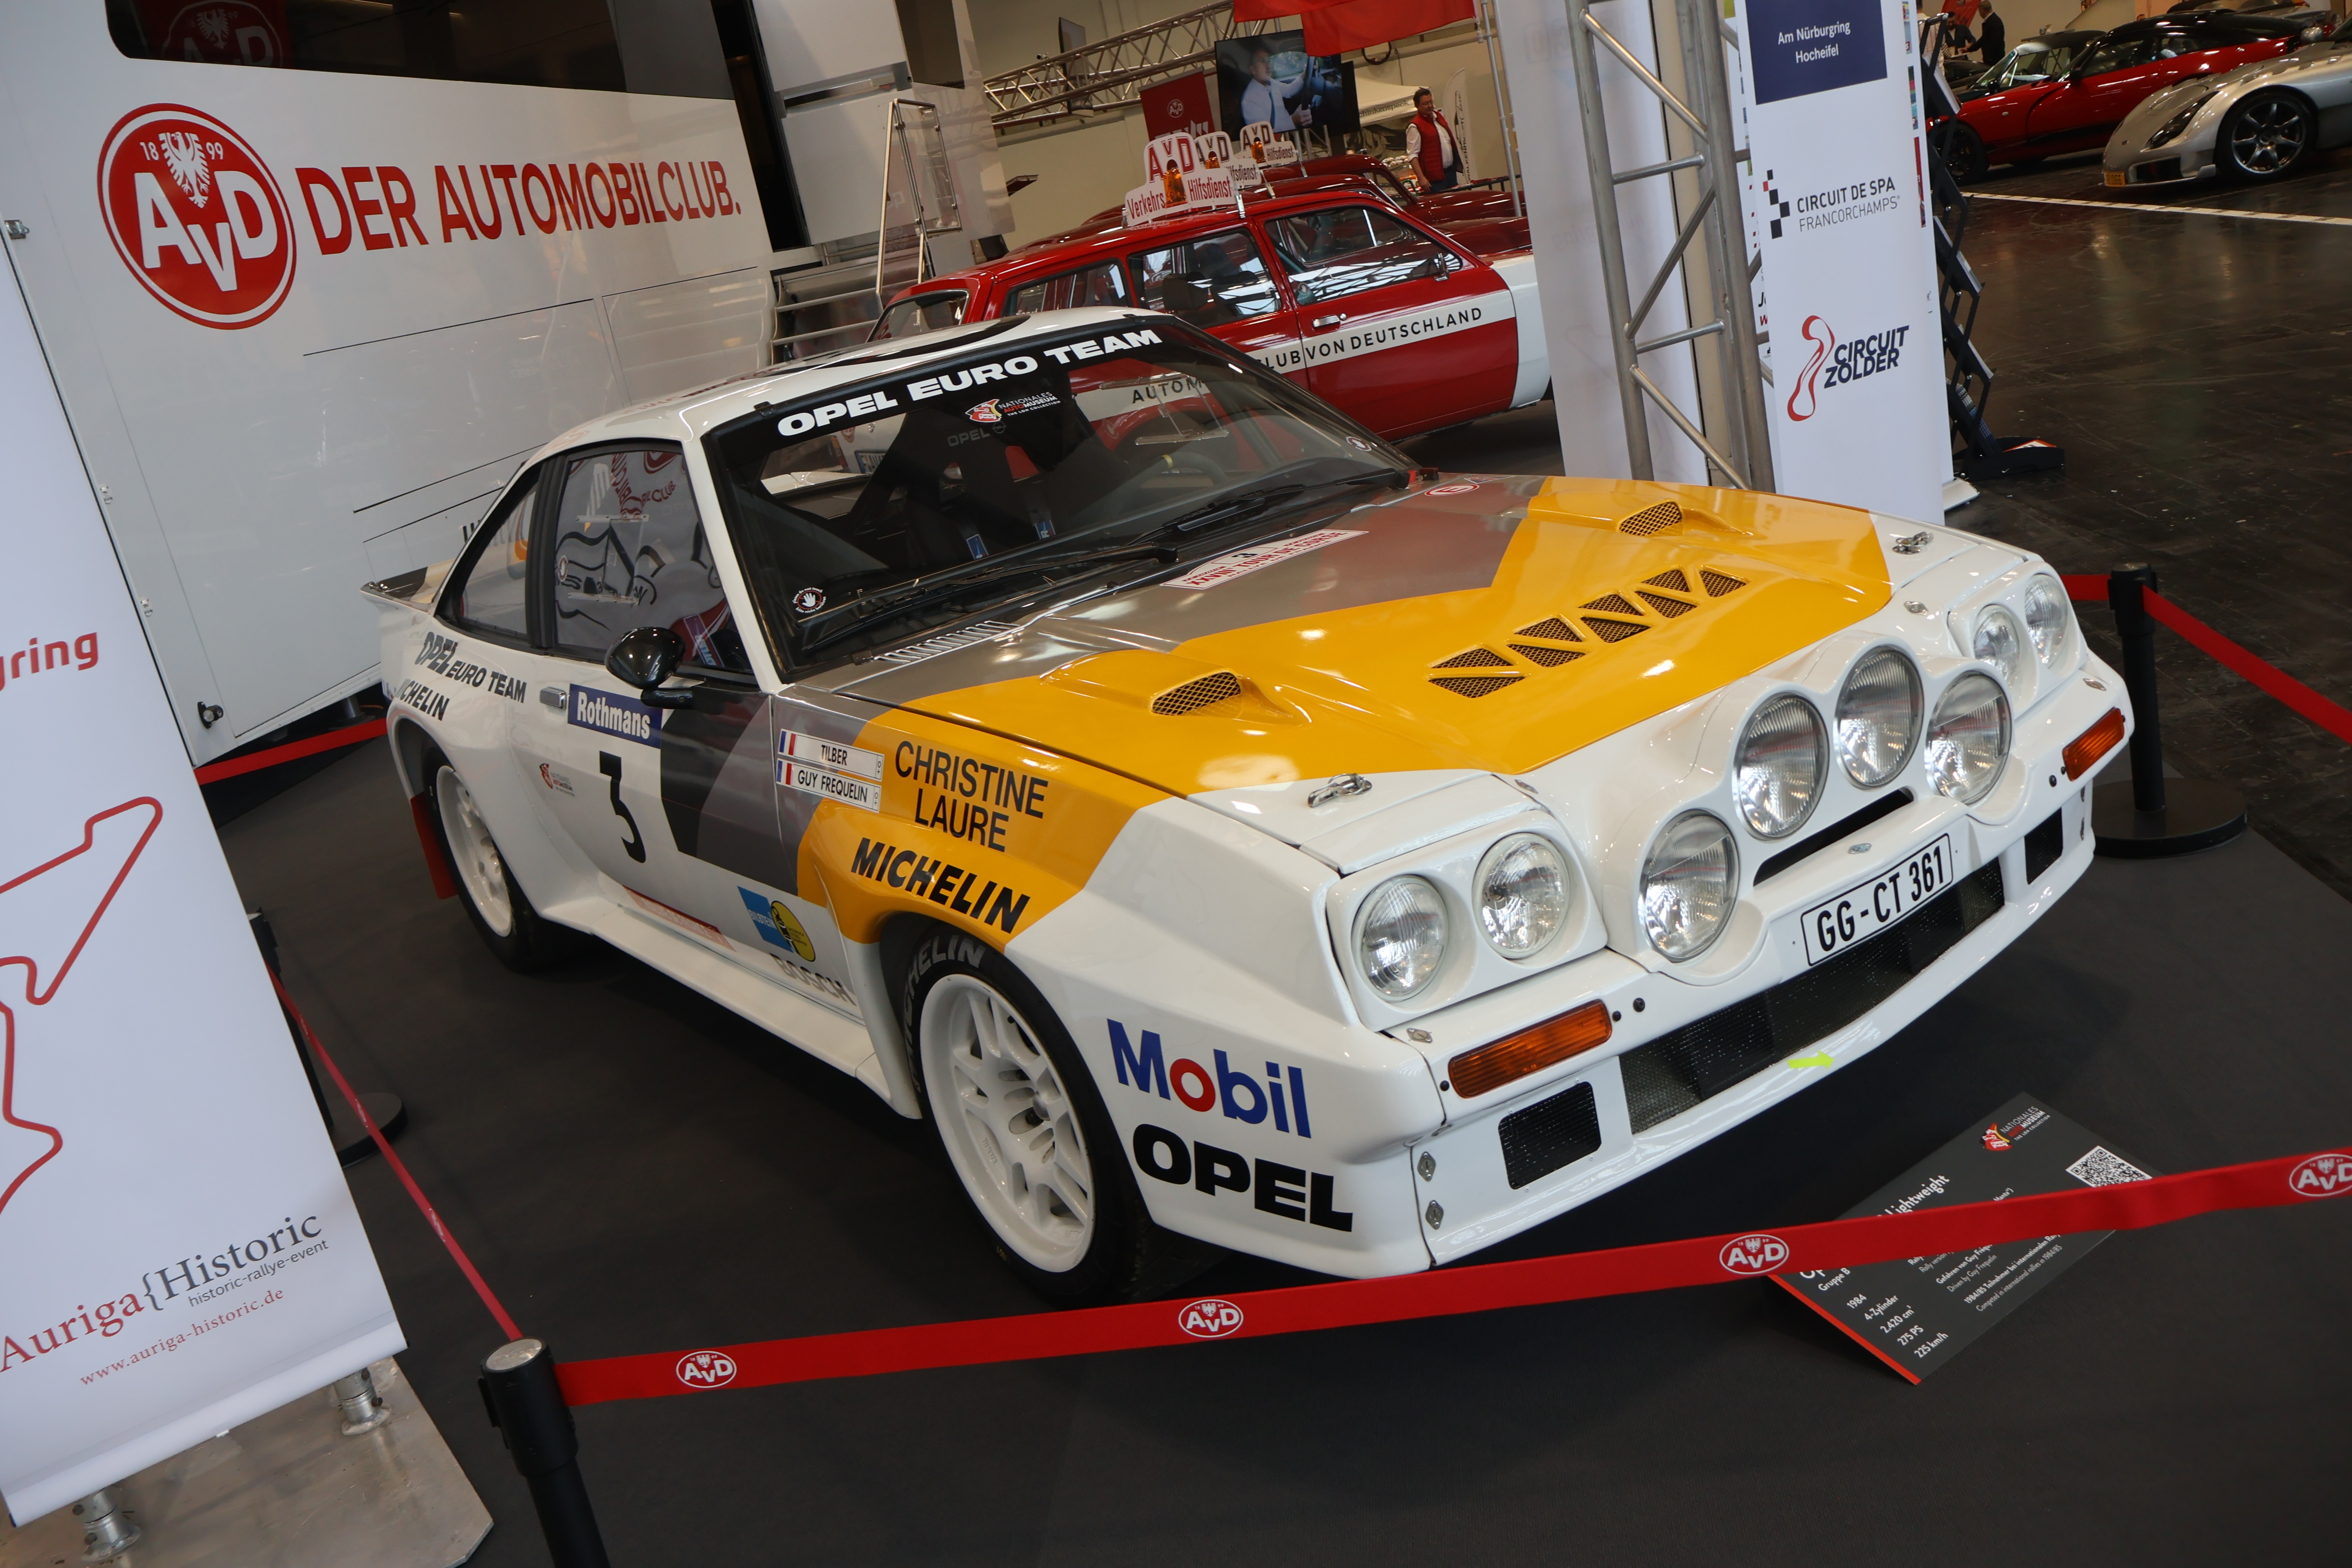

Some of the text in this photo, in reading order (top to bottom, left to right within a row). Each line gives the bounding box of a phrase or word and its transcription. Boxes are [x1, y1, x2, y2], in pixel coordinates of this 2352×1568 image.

[1778, 22, 1851, 45] Am Nürburgring
[1796, 44, 1839, 64] Hocheifel
[1359, 100, 1410, 117] chinkenspeck
[140, 141, 224, 161] 18 99
[1267, 146, 1294, 161] Hilfsdienst
[1224, 164, 1257, 181] lfsdienst
[298, 160, 741, 255] DER AUTOMOBILCLUB.
[1127, 177, 1232, 219] Verkehrs Hilfsdienst
[1797, 177, 1895, 213] CIRCUIT DE SPA
[134, 170, 278, 292] AvD
[1799, 196, 1898, 232] FRANCORCHAMPS
[1305, 339, 1345, 359] VON
[1350, 307, 1482, 350] DEUTSCHLAND
[1834, 325, 1909, 365] CIRCUIT
[777, 329, 1163, 436] OPEL EURO TEAM
[1824, 348, 1899, 389] ZOLDER
[998, 392, 1053, 409] NATIONALES
[1004, 396, 1058, 413] AUTOMUSEUM
[1030, 401, 1062, 411] COLLECTION
[947, 428, 991, 447] OPEL
[1186, 567, 1237, 585] XXVIII
[1232, 554, 1278, 567] TOUR
[1294, 532, 1348, 547] CORSE
[414, 631, 527, 703] OPEL EURO TEAM
[577, 690, 650, 740] Rothmans
[821, 744, 848, 766] TILBER
[798, 769, 818, 788] GUY
[820, 775, 868, 803] FREQUELIN
[895, 740, 1049, 819] CHRISTINE
[599, 750, 646, 864] 3
[915, 788, 1009, 853] LAURE
[851, 837, 1031, 935] MICHELIN
[1909, 846, 1944, 902] 361
[769, 953, 857, 1006] BOSCH
[1107, 1018, 1312, 1139] Mobil
[2000, 1106, 2038, 1133] NATIONALES
[2029, 1114, 2051, 1131] COLLECTION
[1133, 1123, 1353, 1232] OPEL
[1884, 1175, 1950, 1214] Lightweight
[187, 1239, 329, 1308] historic-rallye-event
[1727, 1243, 1785, 1269] AvD
[1918, 1263, 1935, 1273] Rally
[1936, 1266, 1960, 1284] Gefahren
[1958, 1260, 1968, 1270] von
[1965, 1252, 1979, 1263] Guy
[1947, 1254, 1998, 1292] Driven by Guy Frequelin
[1964, 1286, 1987, 1304] 1984/85
[1983, 1268, 2011, 1290] Teilnehmer
[2006, 1261, 2018, 1272] bei
[2016, 1239, 2049, 1268] internationalen
[1818, 1273, 1845, 1291] Gruppe
[1976, 1292, 2000, 1312] Competed
[1998, 1287, 2005, 1296] in
[2003, 1269, 2030, 1292] international
[2027, 1261, 2041, 1274] rallies
[2042, 1244, 2063, 1262] 1984/85
[1846, 1293, 1867, 1309] 1984
[1864, 1295, 1899, 1321] 4-Zylinder
[80, 1288, 284, 1386] www.auriga-historic.de
[1186, 1308, 1240, 1332] AvD
[1880, 1316, 1904, 1334] 2.420
[1897, 1325, 1924, 1346] 275 PS
[1914, 1332, 1949, 1358] 225 km/h
[684, 1359, 733, 1383] AvD
